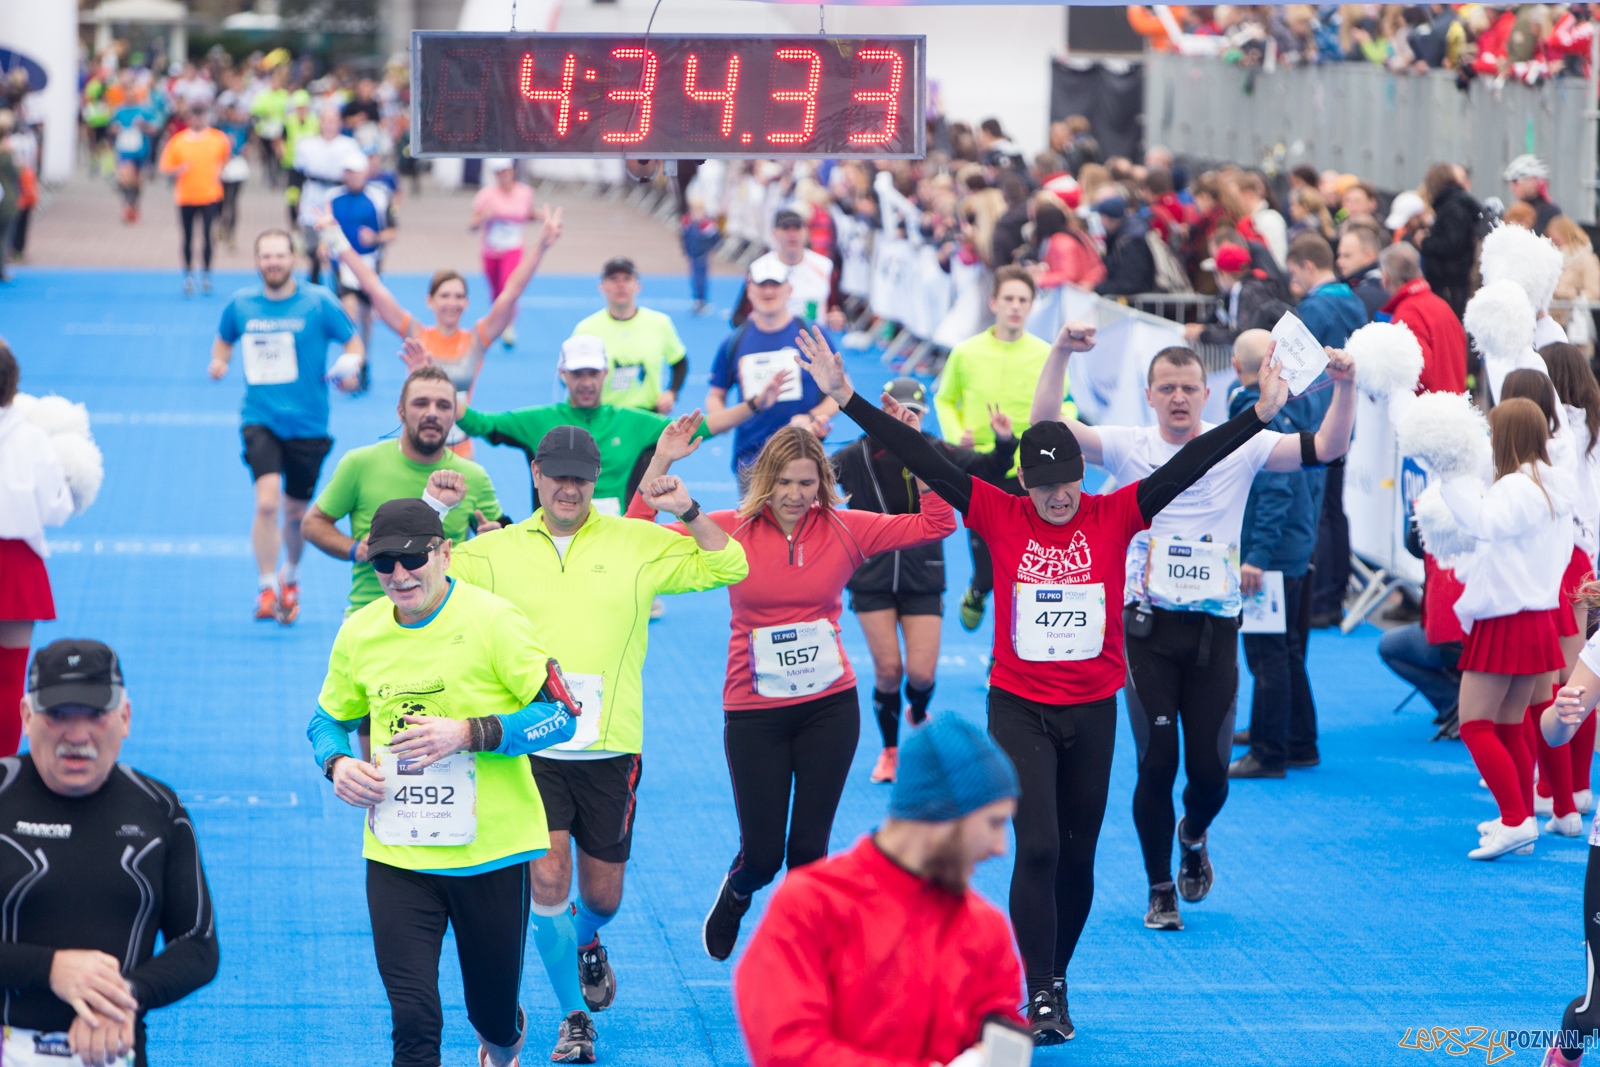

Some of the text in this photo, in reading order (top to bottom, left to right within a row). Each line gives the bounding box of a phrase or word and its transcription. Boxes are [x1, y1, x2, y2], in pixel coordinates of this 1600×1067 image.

[1026, 538, 1076, 560] DRUŻYA
[1167, 563, 1210, 581] 1046
[1038, 592, 1047, 600] 17.
[1047, 592, 1061, 600] PKO
[1035, 611, 1087, 628] 4773
[782, 632, 796, 640] PKO
[1046, 631, 1076, 639] Roman
[776, 645, 819, 667] 1657
[786, 667, 815, 677] Monika
[394, 785, 455, 805] 4592
[397, 809, 452, 818] Piotr Leszek
